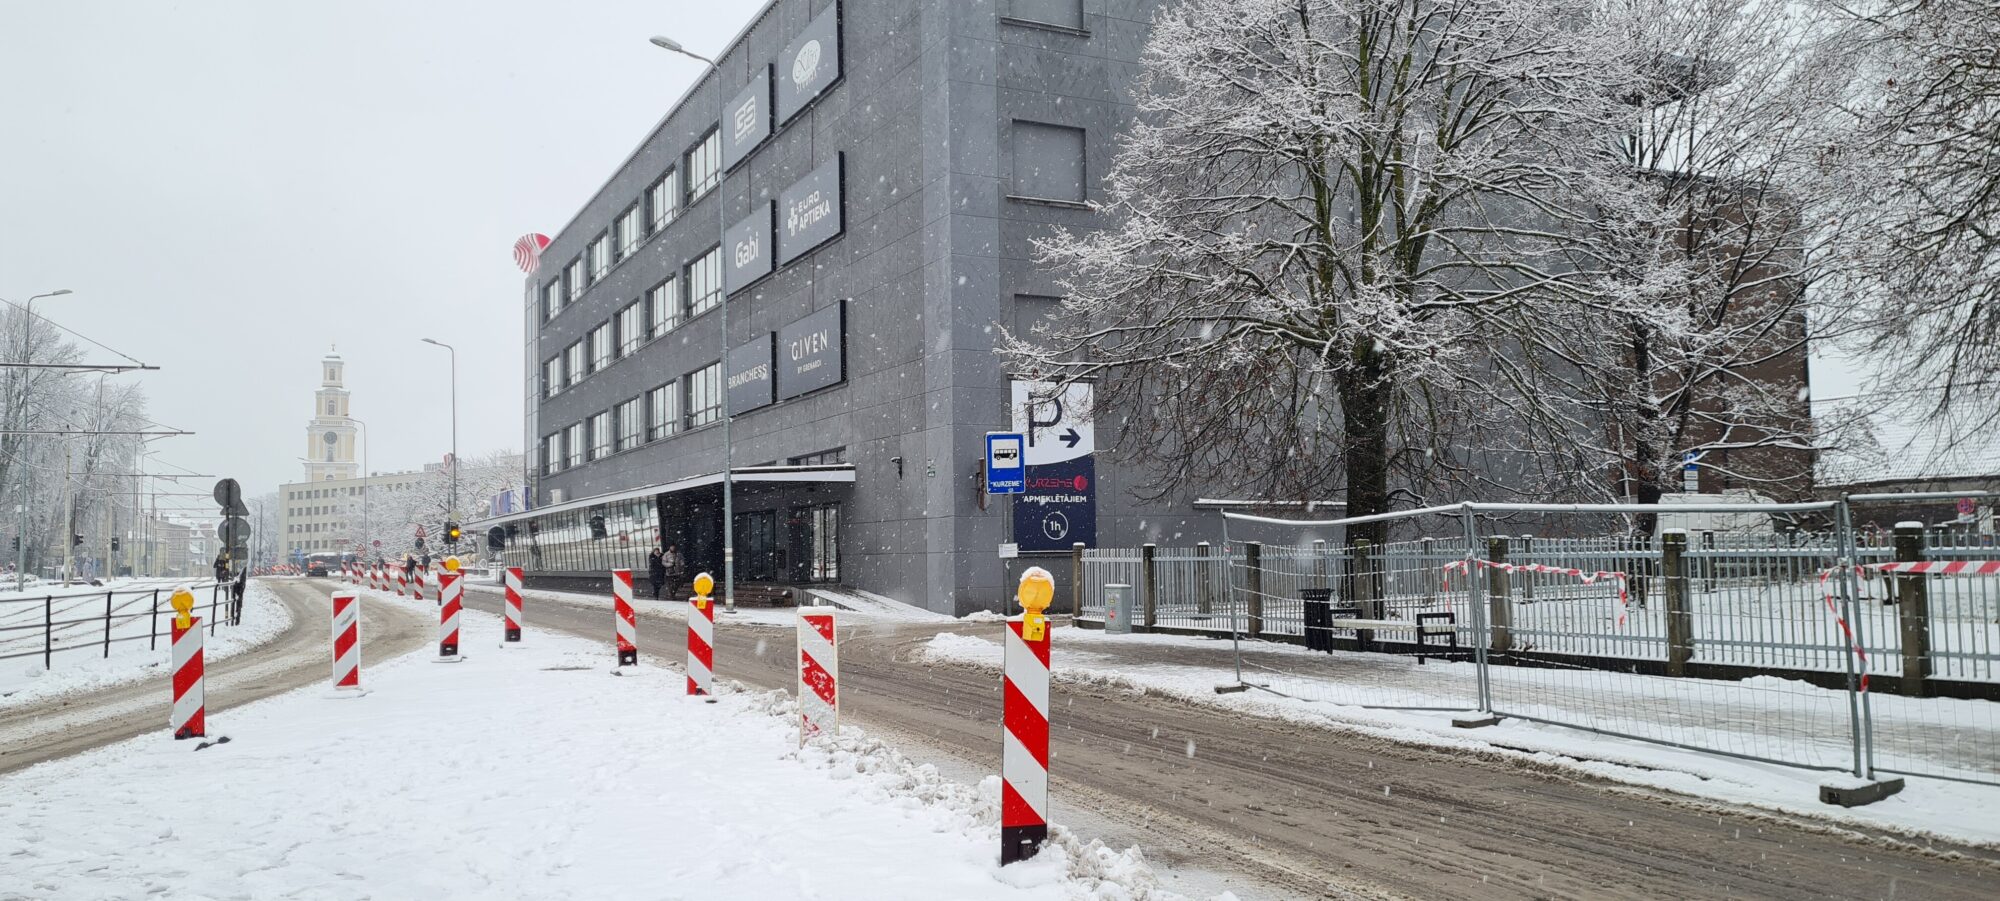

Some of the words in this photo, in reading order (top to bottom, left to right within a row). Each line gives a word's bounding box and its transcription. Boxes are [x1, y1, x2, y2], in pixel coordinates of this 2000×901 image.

[798, 190, 820, 213] EURO
[799, 199, 831, 231] APTIEKA
[736, 231, 759, 268] Gabi
[791, 328, 828, 360] GIVEN
[727, 363, 768, 389] BRANCHESS
[1028, 391, 1063, 447] P
[1023, 494, 1087, 503] APMEKLĒTĀJIEM
[1050, 521, 1061, 531] 1h
